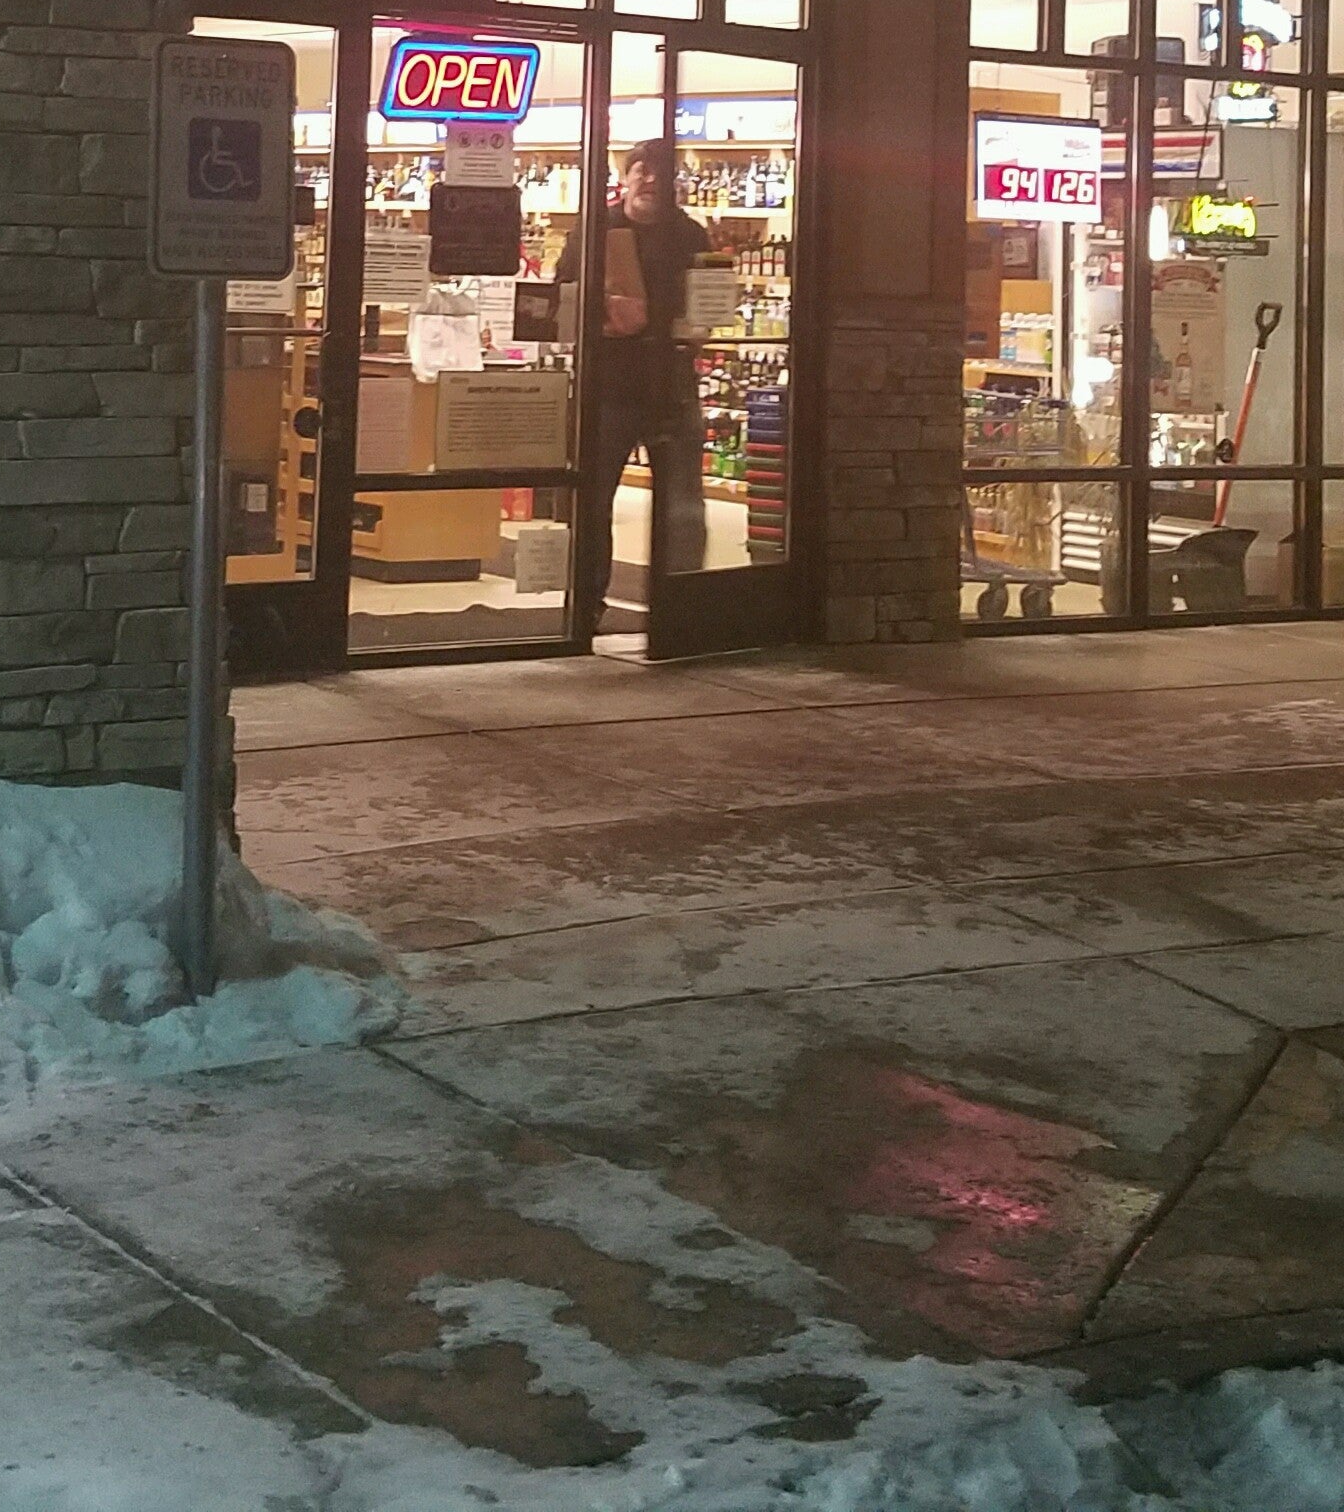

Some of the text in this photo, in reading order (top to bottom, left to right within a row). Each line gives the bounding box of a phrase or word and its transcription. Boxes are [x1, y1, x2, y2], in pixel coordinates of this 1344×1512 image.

[170, 55, 282, 83] RESERVED
[398, 53, 529, 108] OPEN
[179, 83, 273, 109] PARKING
[1001, 168, 1095, 203] 94 126
